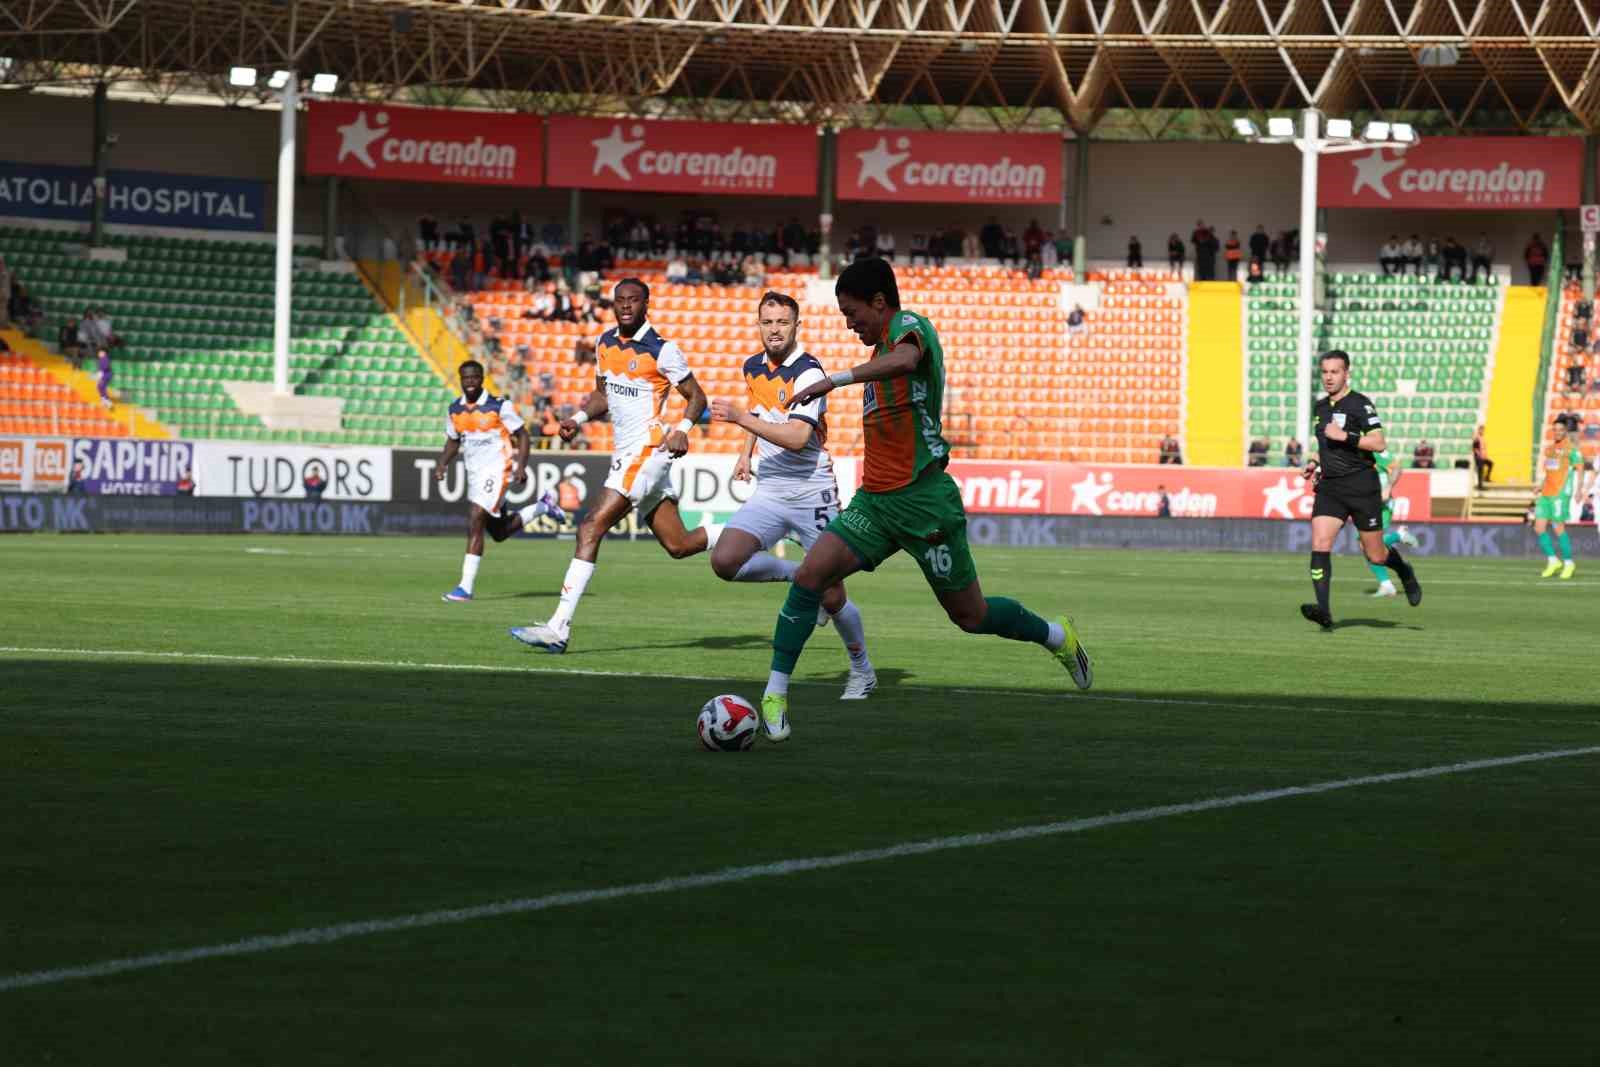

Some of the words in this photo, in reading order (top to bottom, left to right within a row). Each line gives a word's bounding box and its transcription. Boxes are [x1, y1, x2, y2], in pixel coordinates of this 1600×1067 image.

[381, 136, 516, 168] corendon
[638, 146, 777, 177] corendon
[903, 157, 1047, 188] corendon
[1399, 161, 1545, 193] corendon
[109, 185, 254, 220] HOSPITAL
[227, 456, 374, 497] TUDORS
[413, 458, 587, 503] TUORS
[483, 478, 495, 494] 8
[242, 501, 335, 532] PONTO
[341, 504, 372, 532] MK
[924, 543, 953, 578] 16
